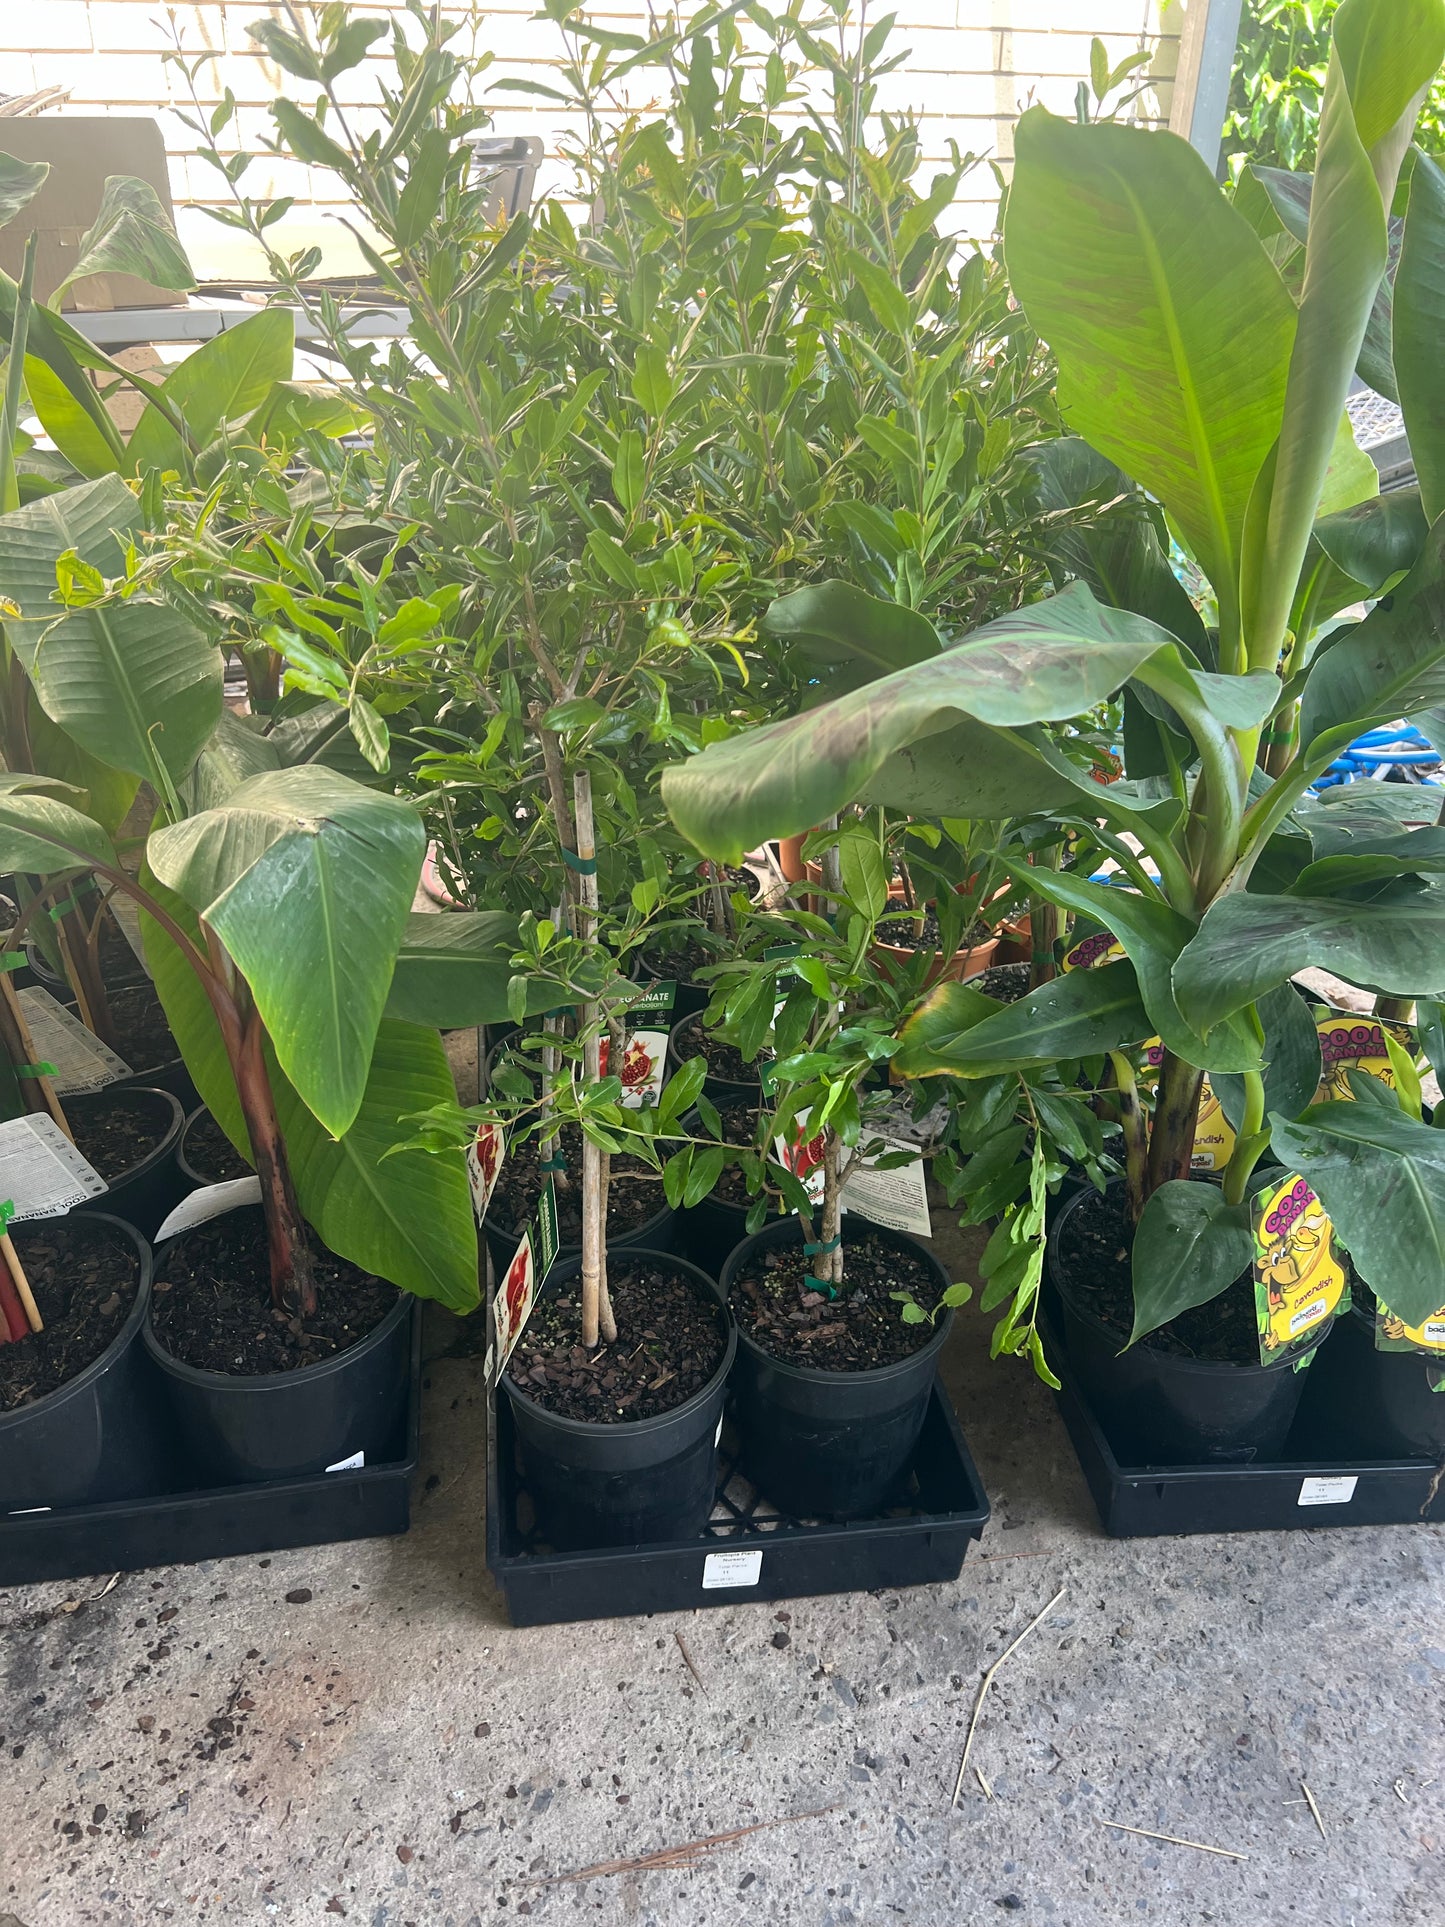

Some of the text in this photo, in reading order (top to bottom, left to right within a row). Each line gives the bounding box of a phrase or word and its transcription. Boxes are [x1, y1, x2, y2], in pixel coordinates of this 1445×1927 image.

[1318, 1026, 1385, 1050] COOL
[1323, 1044, 1389, 1062] BANANA
[1192, 1134, 1225, 1146] endish
[8, 1195, 87, 1223] COOL BANANAS
[1265, 1179, 1308, 1233] COO
[1277, 1192, 1316, 1236] BANAN
[1294, 1275, 1333, 1310] Cavendish
